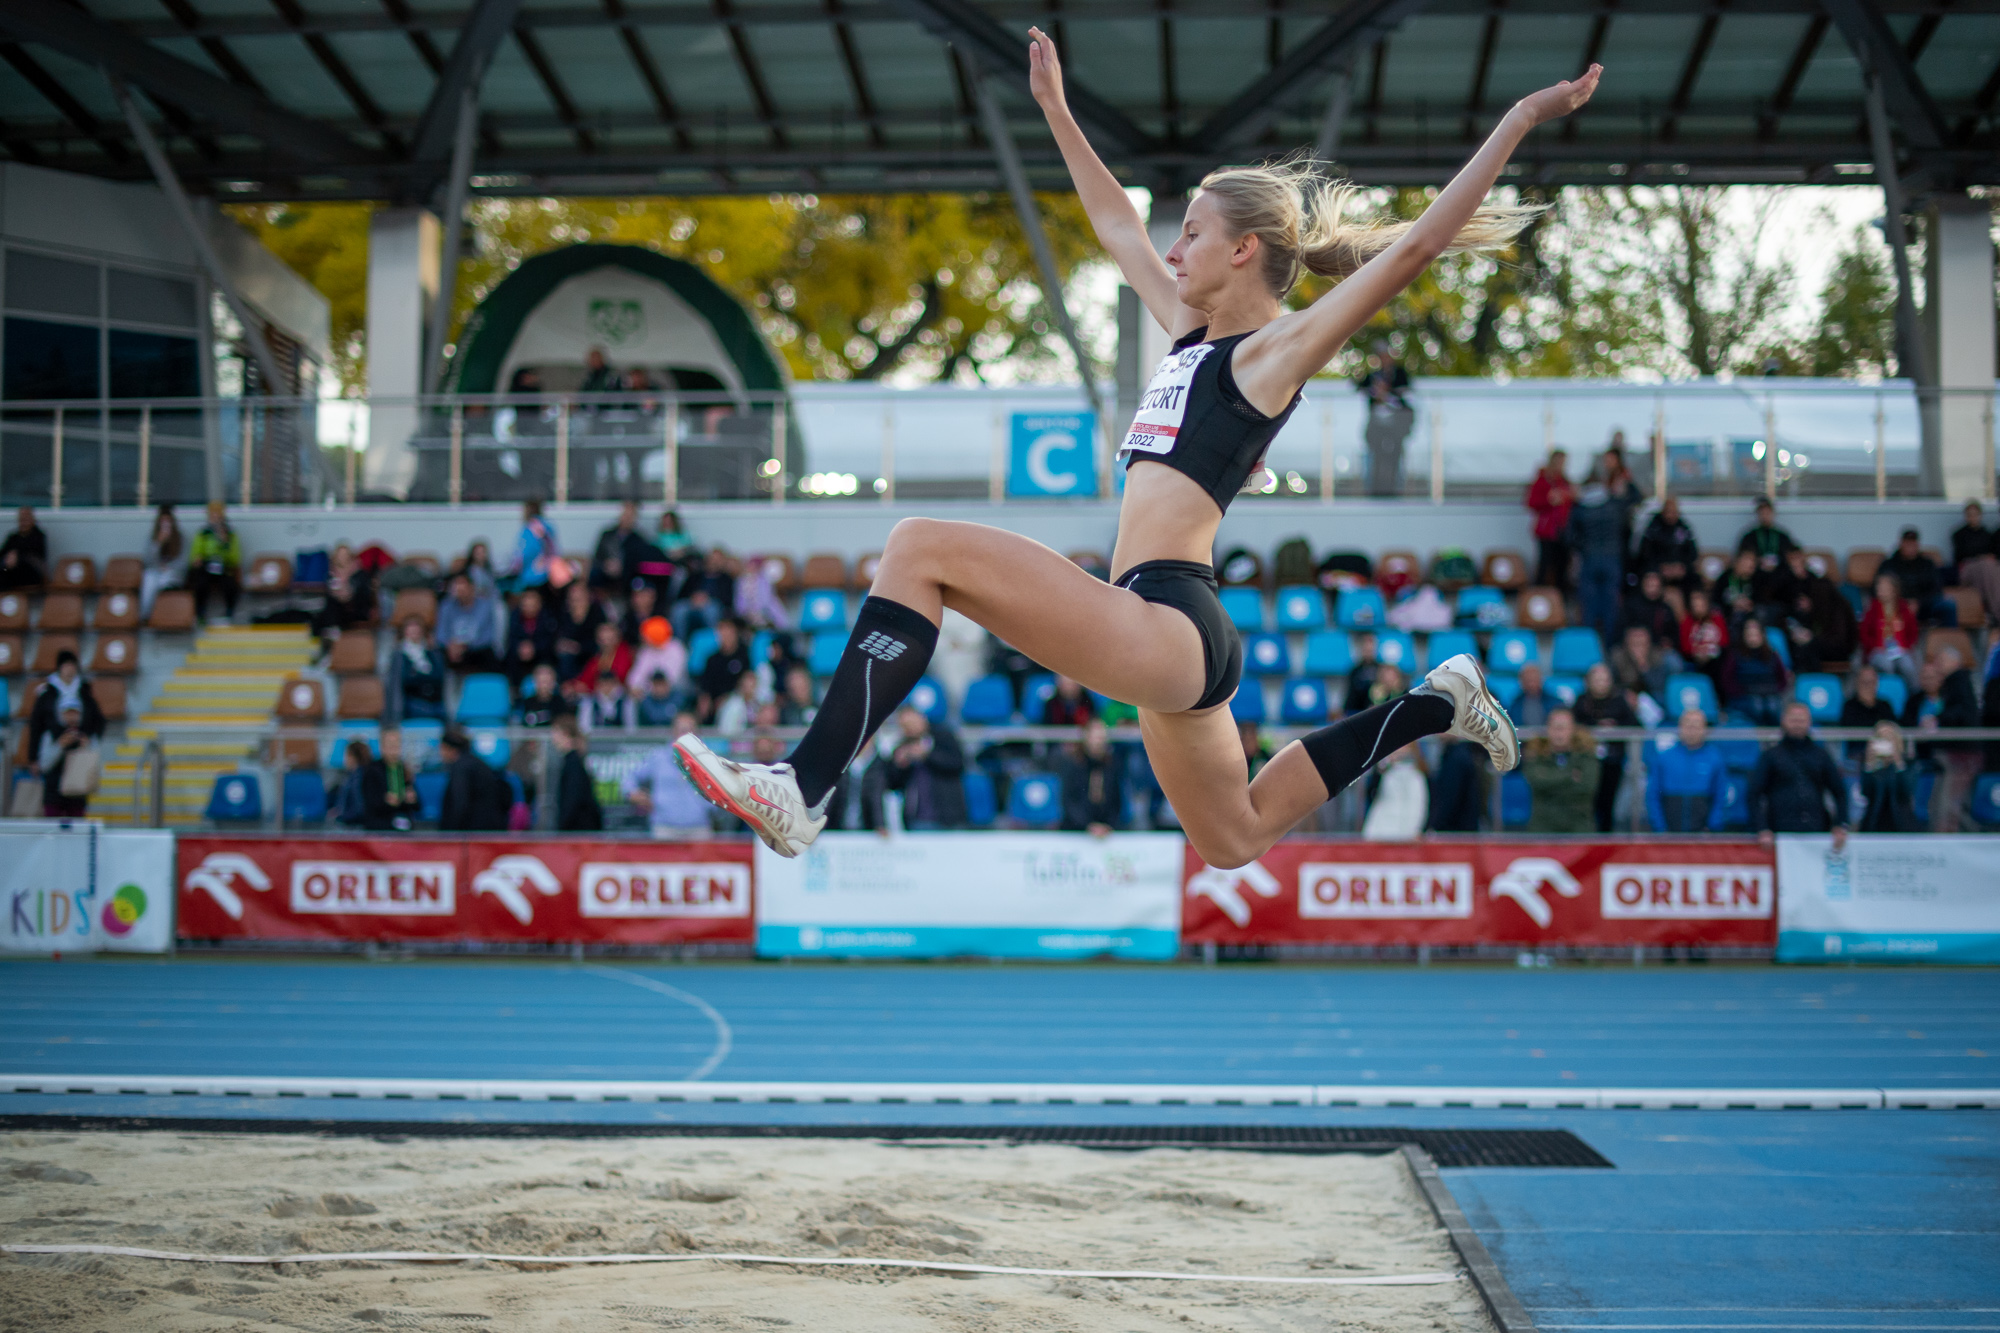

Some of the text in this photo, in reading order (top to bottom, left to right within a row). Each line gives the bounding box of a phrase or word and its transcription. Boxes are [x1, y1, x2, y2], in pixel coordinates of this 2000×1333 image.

[1128, 433, 1155, 447] 2022
[1026, 431, 1078, 494] C
[858, 643, 894, 661] cep
[303, 873, 440, 902] ORLEN
[594, 877, 734, 905] ORLEN
[1314, 877, 1457, 905] ORLEN
[1615, 878, 1760, 906] ORLEN
[11, 888, 90, 937] KIDS
